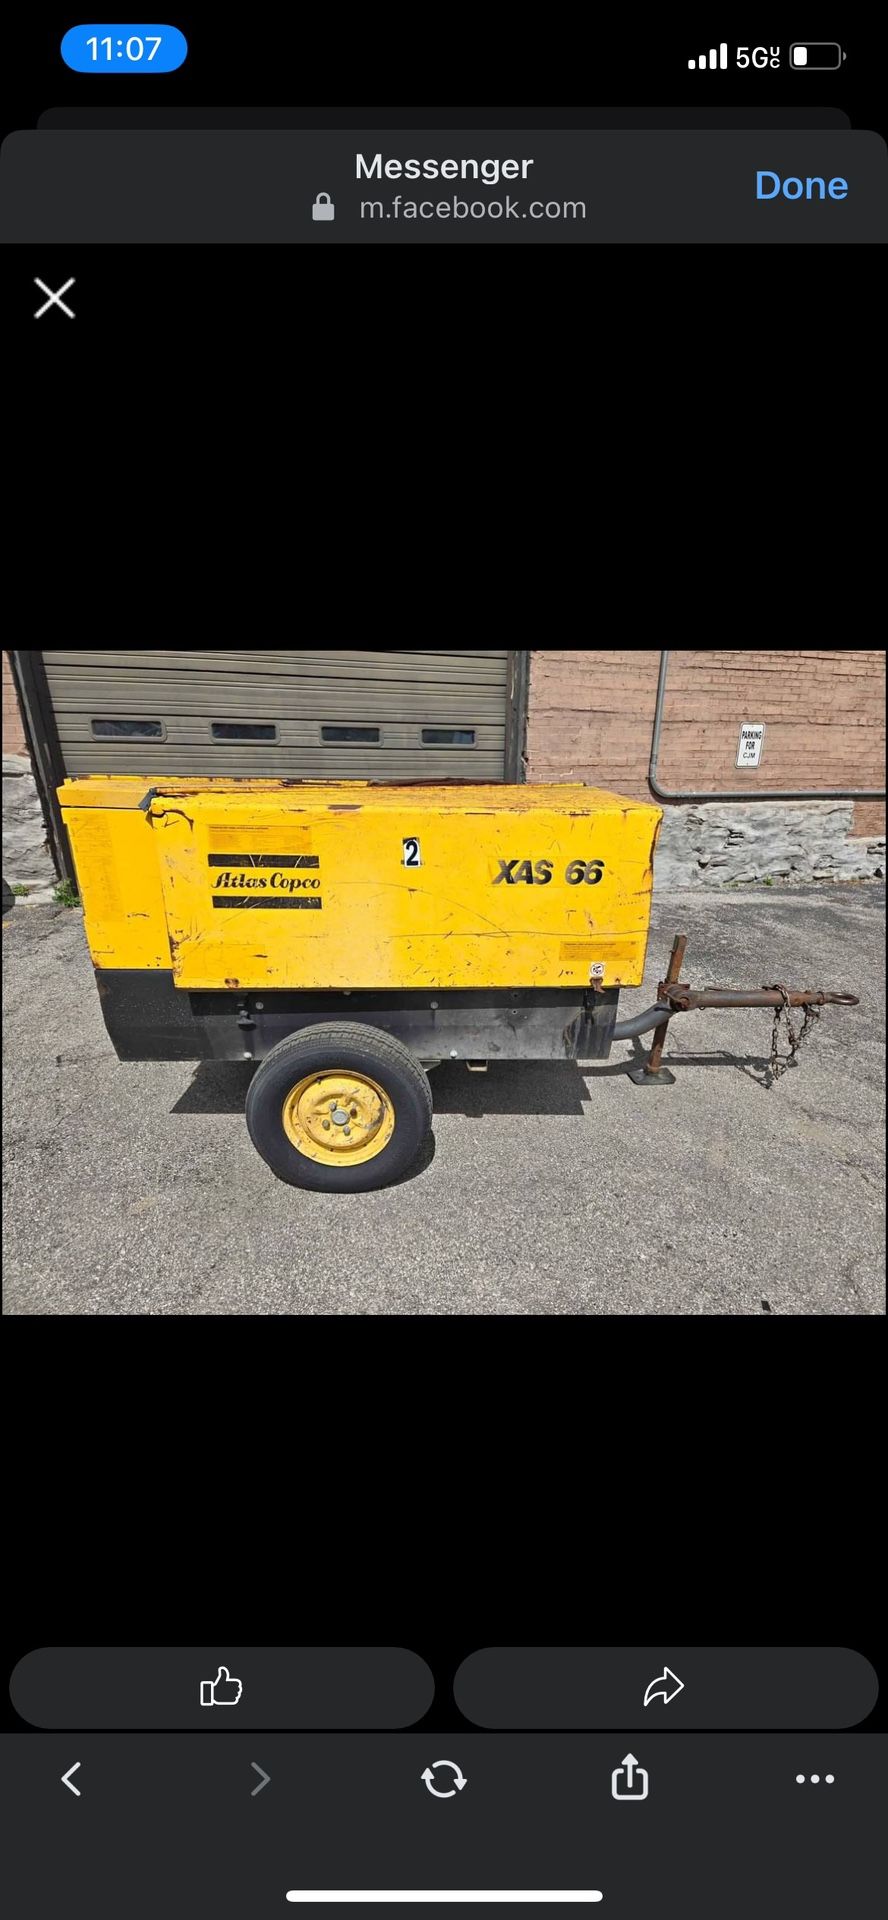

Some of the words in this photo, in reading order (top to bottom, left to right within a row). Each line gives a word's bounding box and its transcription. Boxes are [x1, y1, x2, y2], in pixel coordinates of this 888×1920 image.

[742, 730, 762, 740] PARKING
[745, 741, 755, 750] FOR
[405, 840, 418, 866] 2
[211, 872, 267, 889] Atlas
[270, 872, 321, 892] Copco
[492, 860, 554, 885] XAS
[565, 859, 605, 885] 66
